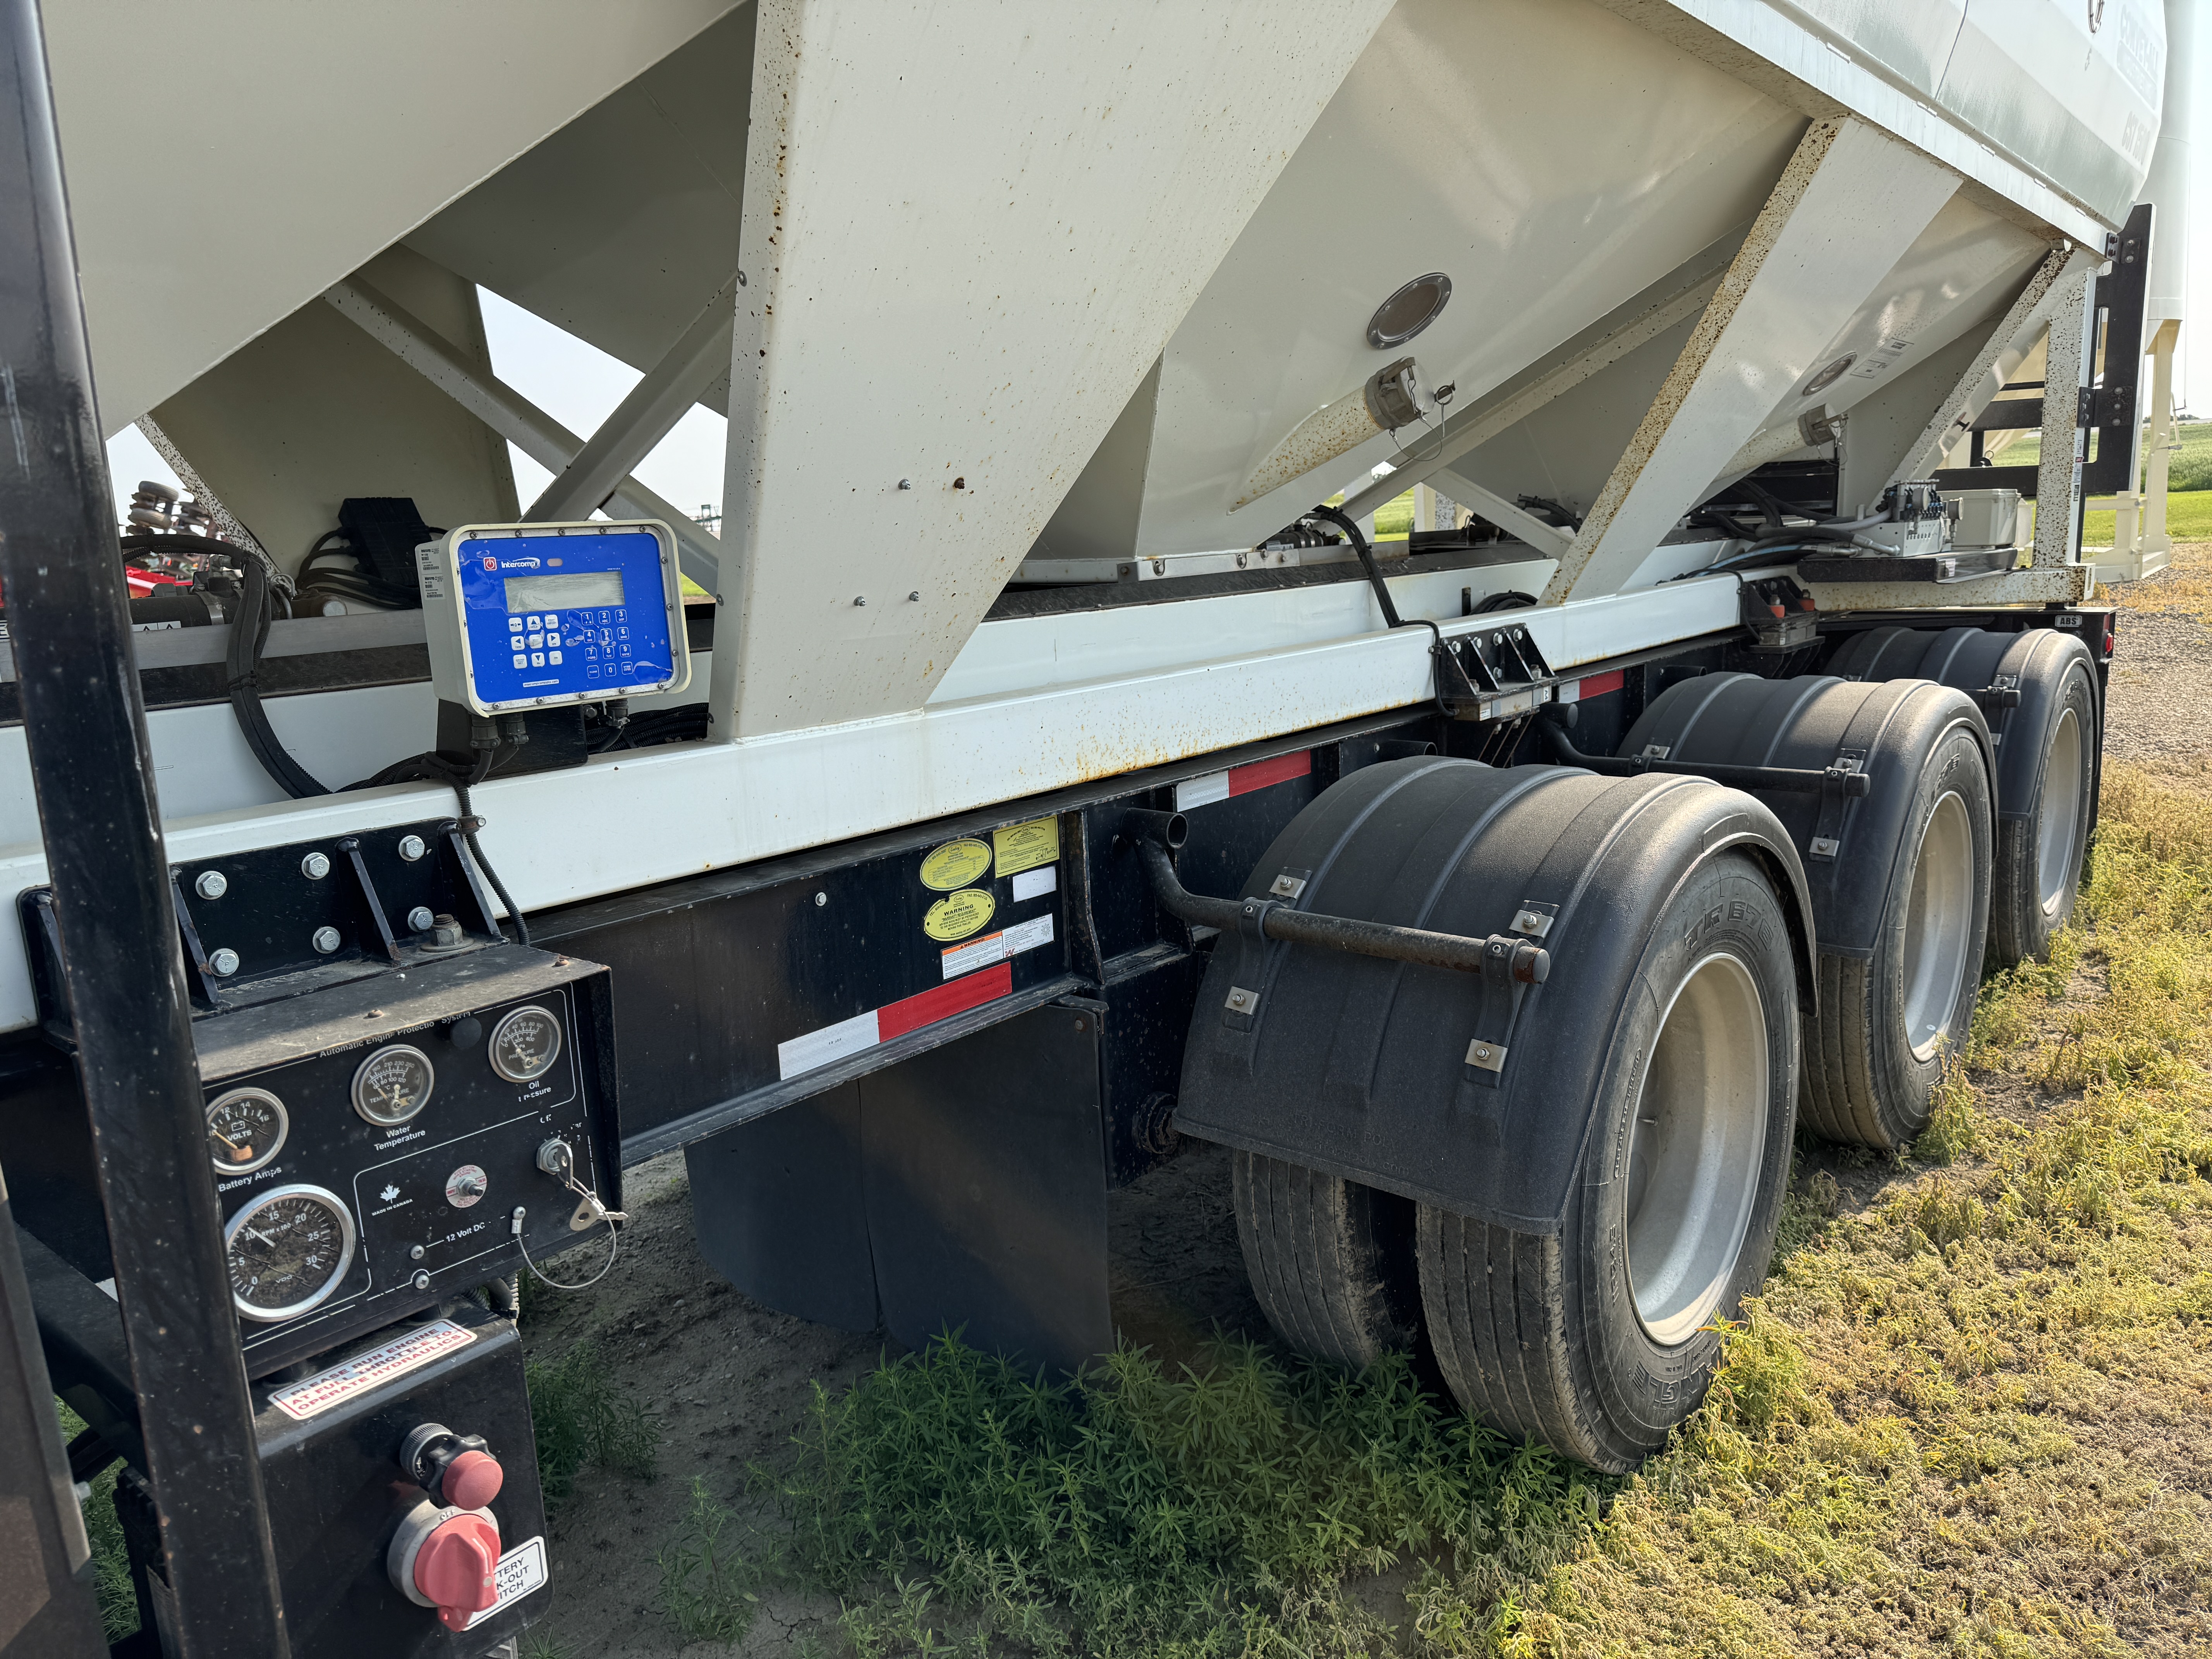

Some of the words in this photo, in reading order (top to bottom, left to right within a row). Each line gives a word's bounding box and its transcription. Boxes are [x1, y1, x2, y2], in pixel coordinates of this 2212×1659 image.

[944, 904, 974, 916] WARNING
[964, 938, 985, 947] WARNING!
[319, 1040, 364, 1058] Automatic
[398, 1022, 434, 1035] Protectio
[508, 1049, 534, 1060] PRESURE
[529, 1081, 539, 1089] Oil
[227, 1130, 252, 1141] VOLTS
[386, 1126, 410, 1138] Water
[374, 1130, 426, 1151] Temperature
[218, 1176, 252, 1192] Battery
[393, 1199, 413, 1208] CANADA
[269, 1211, 280, 1221] 15
[295, 1213, 307, 1225] 20
[245, 1231, 256, 1241] 10
[261, 1228, 275, 1237] RPM
[281, 1223, 291, 1231] 100
[308, 1232, 319, 1242] 25
[446, 1234, 456, 1242] 12
[457, 1228, 472, 1238] Volt
[473, 1222, 485, 1232] DC
[239, 1257, 245, 1266] 5
[306, 1255, 317, 1266] 30
[251, 1276, 258, 1285] 0
[275, 1275, 293, 1283] VDO
[290, 1369, 350, 1395] PLEASE
[352, 1353, 384, 1369] RUN
[386, 1329, 439, 1354] ENGINE
[292, 1393, 310, 1405] AT
[315, 1377, 350, 1394] FULL
[355, 1340, 434, 1375] THROTTLE
[436, 1330, 452, 1341] TO
[298, 1376, 370, 1410] OPERATE
[373, 1334, 462, 1376] HYDRAULICS
[494, 1557, 524, 1581] TERY
[496, 1565, 529, 1590] K-OUT
[498, 1580, 524, 1599] ITCH
